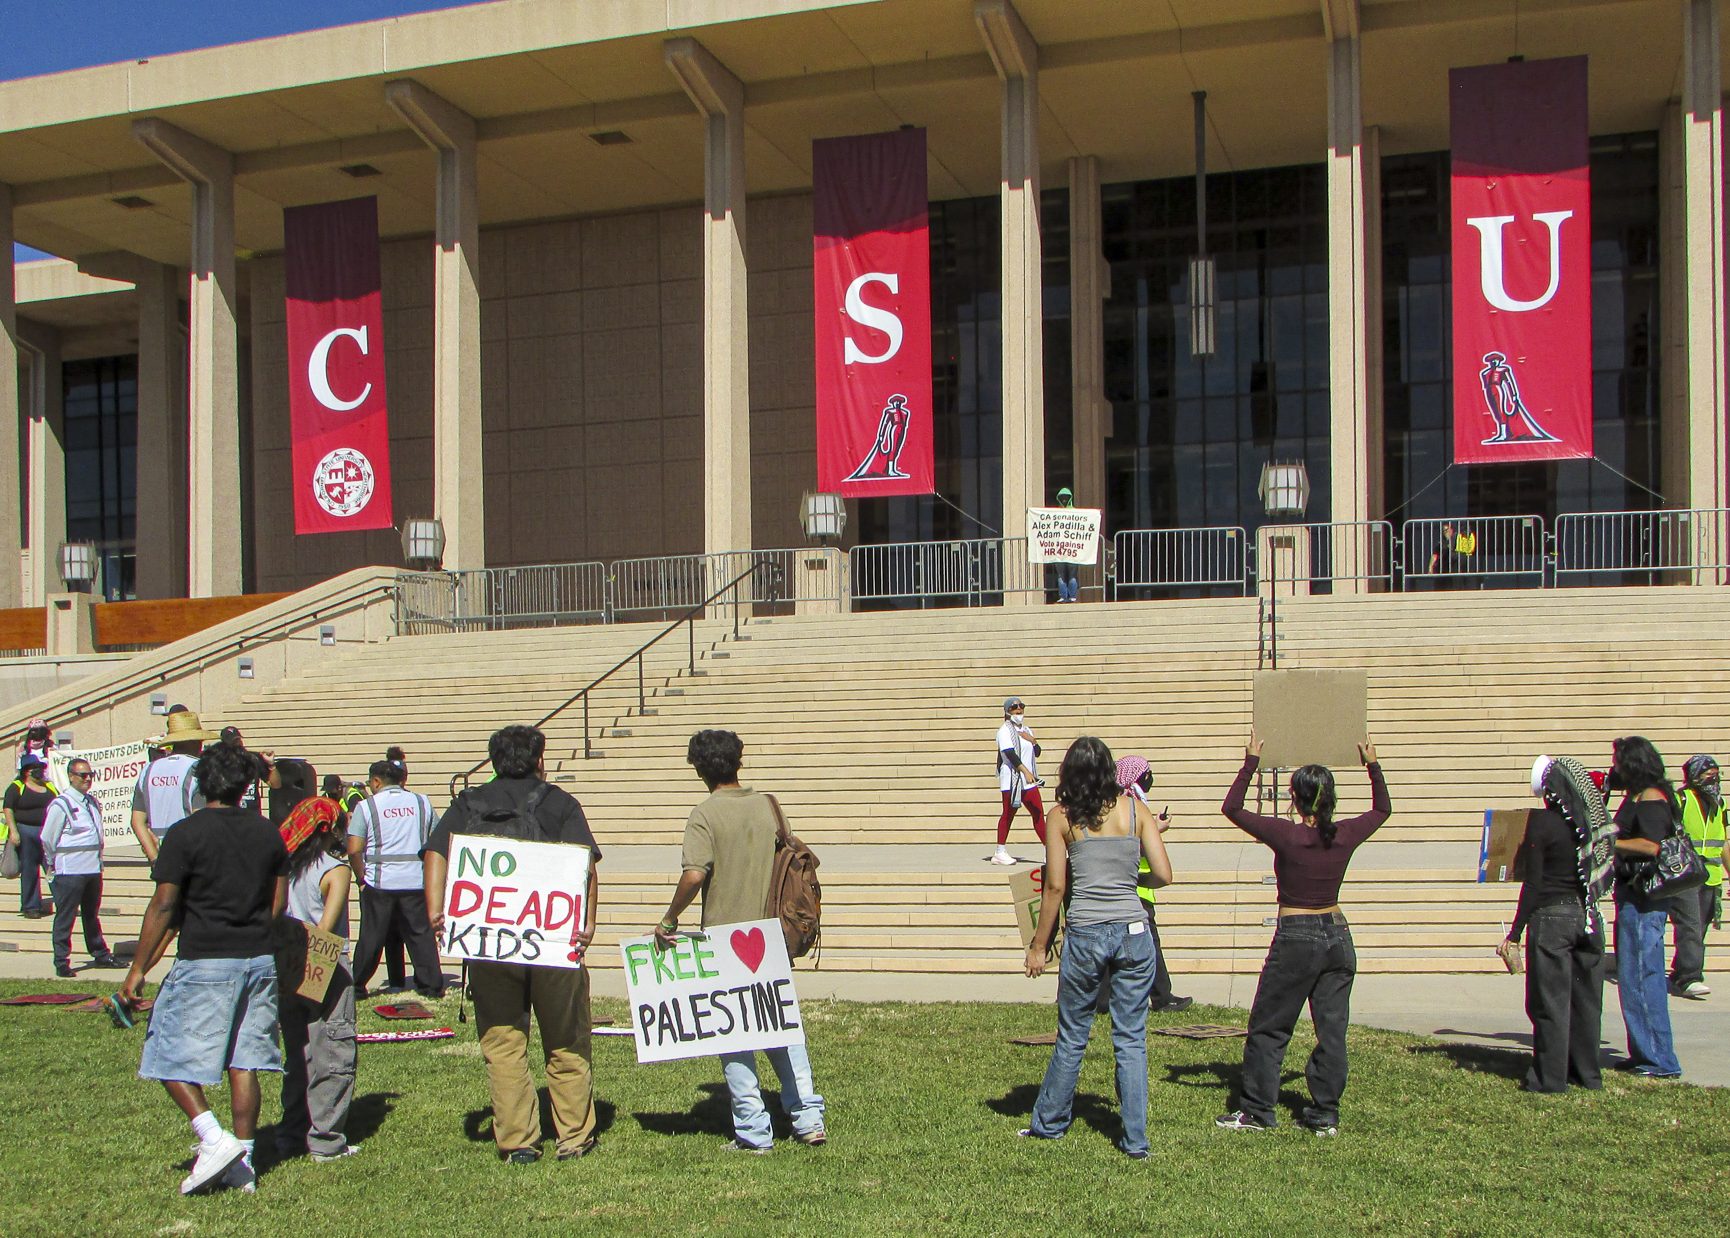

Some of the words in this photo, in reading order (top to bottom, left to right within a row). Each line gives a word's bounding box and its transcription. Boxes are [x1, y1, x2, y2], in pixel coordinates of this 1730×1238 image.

[1466, 210, 1573, 312] U
[844, 272, 903, 365] S
[308, 325, 372, 411] C
[1040, 513, 1051, 521] CA
[1032, 521, 1051, 530] Alex
[1053, 521, 1085, 531] Padilla
[1088, 523, 1095, 532] &
[1036, 530, 1060, 539] Adam
[1063, 530, 1092, 541] Schiff
[1039, 540, 1055, 548] Vote
[1055, 541, 1084, 550] against
[1044, 548, 1056, 556] HR
[83, 746, 126, 762] STUDENTS
[104, 761, 146, 782] DIVEST
[151, 776, 178, 787] CSUN
[104, 802, 116, 811] OR
[116, 799, 132, 810] PRO
[102, 814, 123, 825] ANCE
[383, 806, 416, 819] CSUN
[103, 827, 124, 837] DING
[458, 846, 517, 878] NO
[308, 934, 340, 963] DENTS
[625, 937, 720, 986] FREE
[304, 961, 324, 982] AR
[638, 978, 800, 1047] PALESTINE
